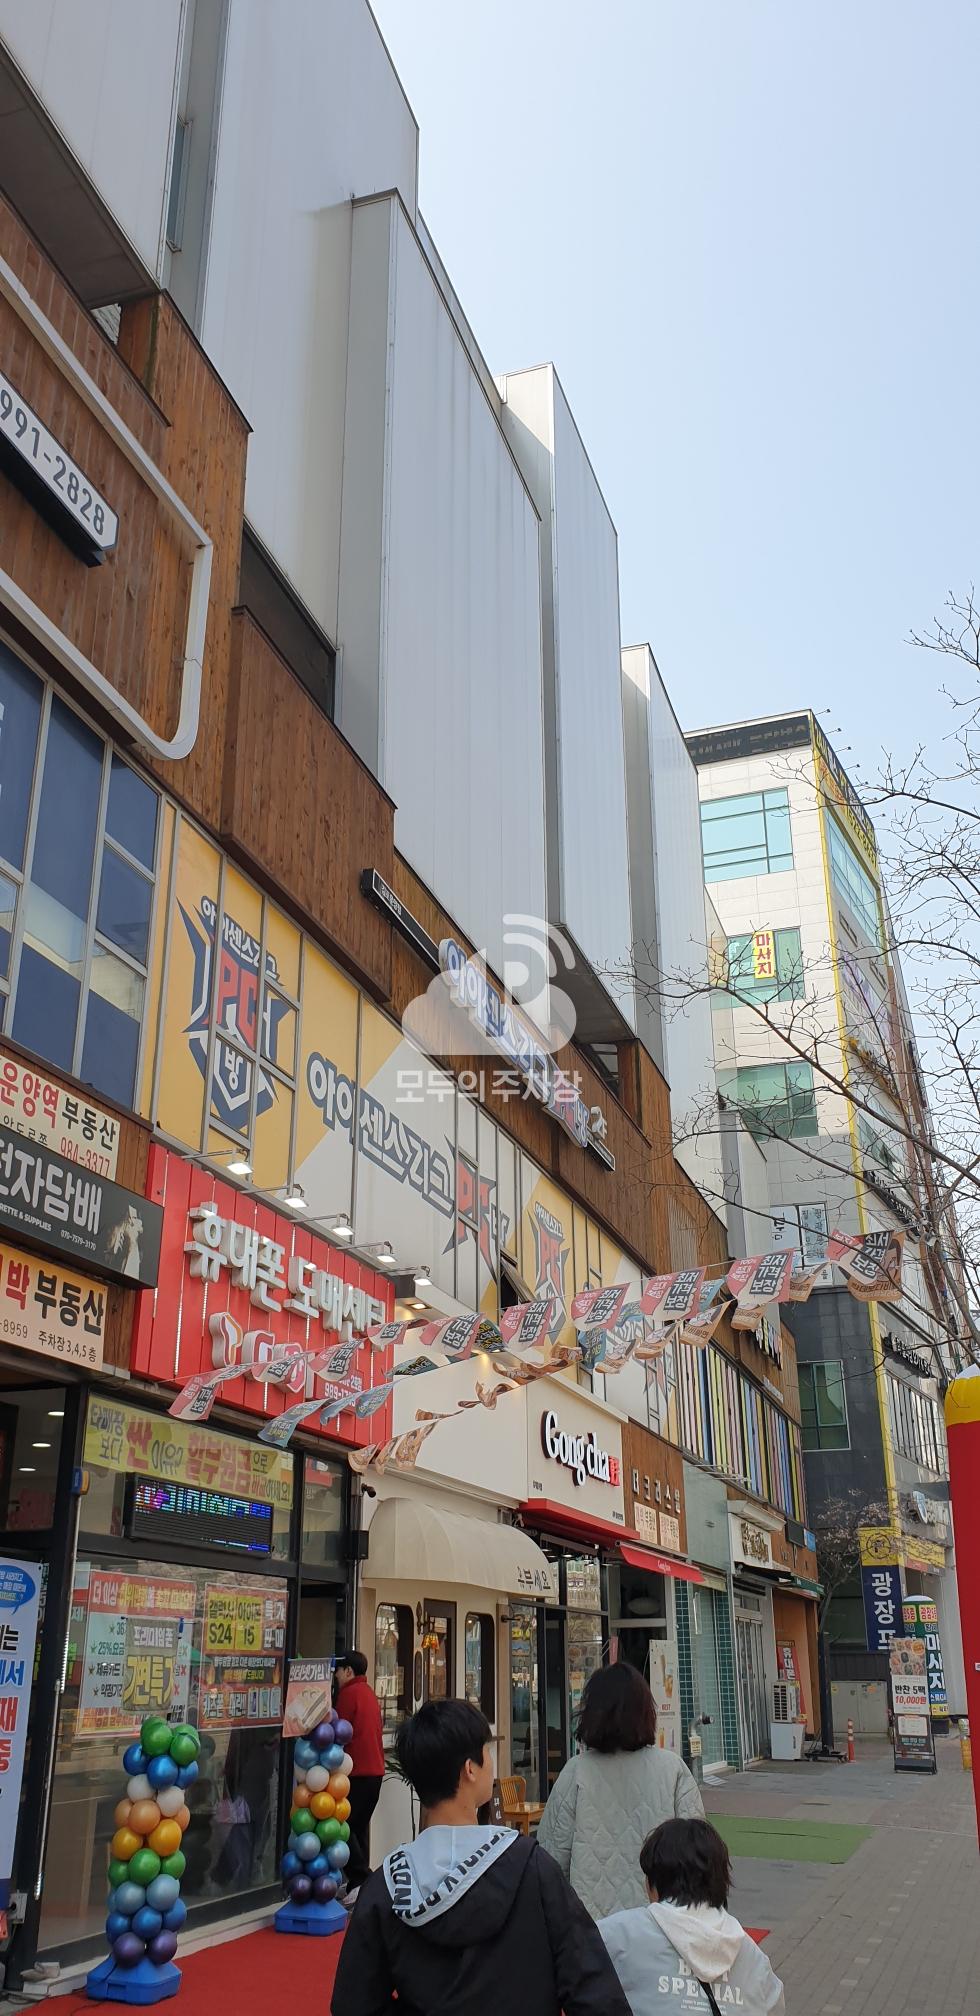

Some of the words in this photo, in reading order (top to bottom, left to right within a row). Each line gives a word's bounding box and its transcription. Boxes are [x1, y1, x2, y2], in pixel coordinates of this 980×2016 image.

[755, 933, 772, 976] 마사지
[0, 1062, 60, 1129] 운양역
[61, 1096, 117, 1152] 부동산
[308, 1057, 454, 1218] 아이센스리그
[24, 1214, 52, 1232] SUPPLIES
[184, 1202, 288, 1313] 휴대폰
[760, 1254, 788, 1266] 최저
[850, 1254, 877, 1277] 보장
[674, 1271, 700, 1283] 최저
[757, 1265, 782, 1279] 가격
[670, 1282, 694, 1295] 가격
[749, 1279, 777, 1293] 보장
[34, 1269, 104, 1337] 부동산
[527, 1301, 549, 1313] 최저
[594, 1298, 615, 1311] 가격
[664, 1295, 688, 1309] 보장
[452, 1319, 473, 1335] 가격
[523, 1312, 544, 1326] 가격
[38, 1330, 65, 1352] 주차장
[442, 1329, 466, 1348] 보장
[541, 1410, 586, 1487] Gong
[586, 1431, 611, 1482] cha
[208, 1622, 233, 1645] S24
[243, 1625, 256, 1645] 15
[894, 1684, 910, 1695] 반찬
[895, 1695, 927, 1705] 10,000원
